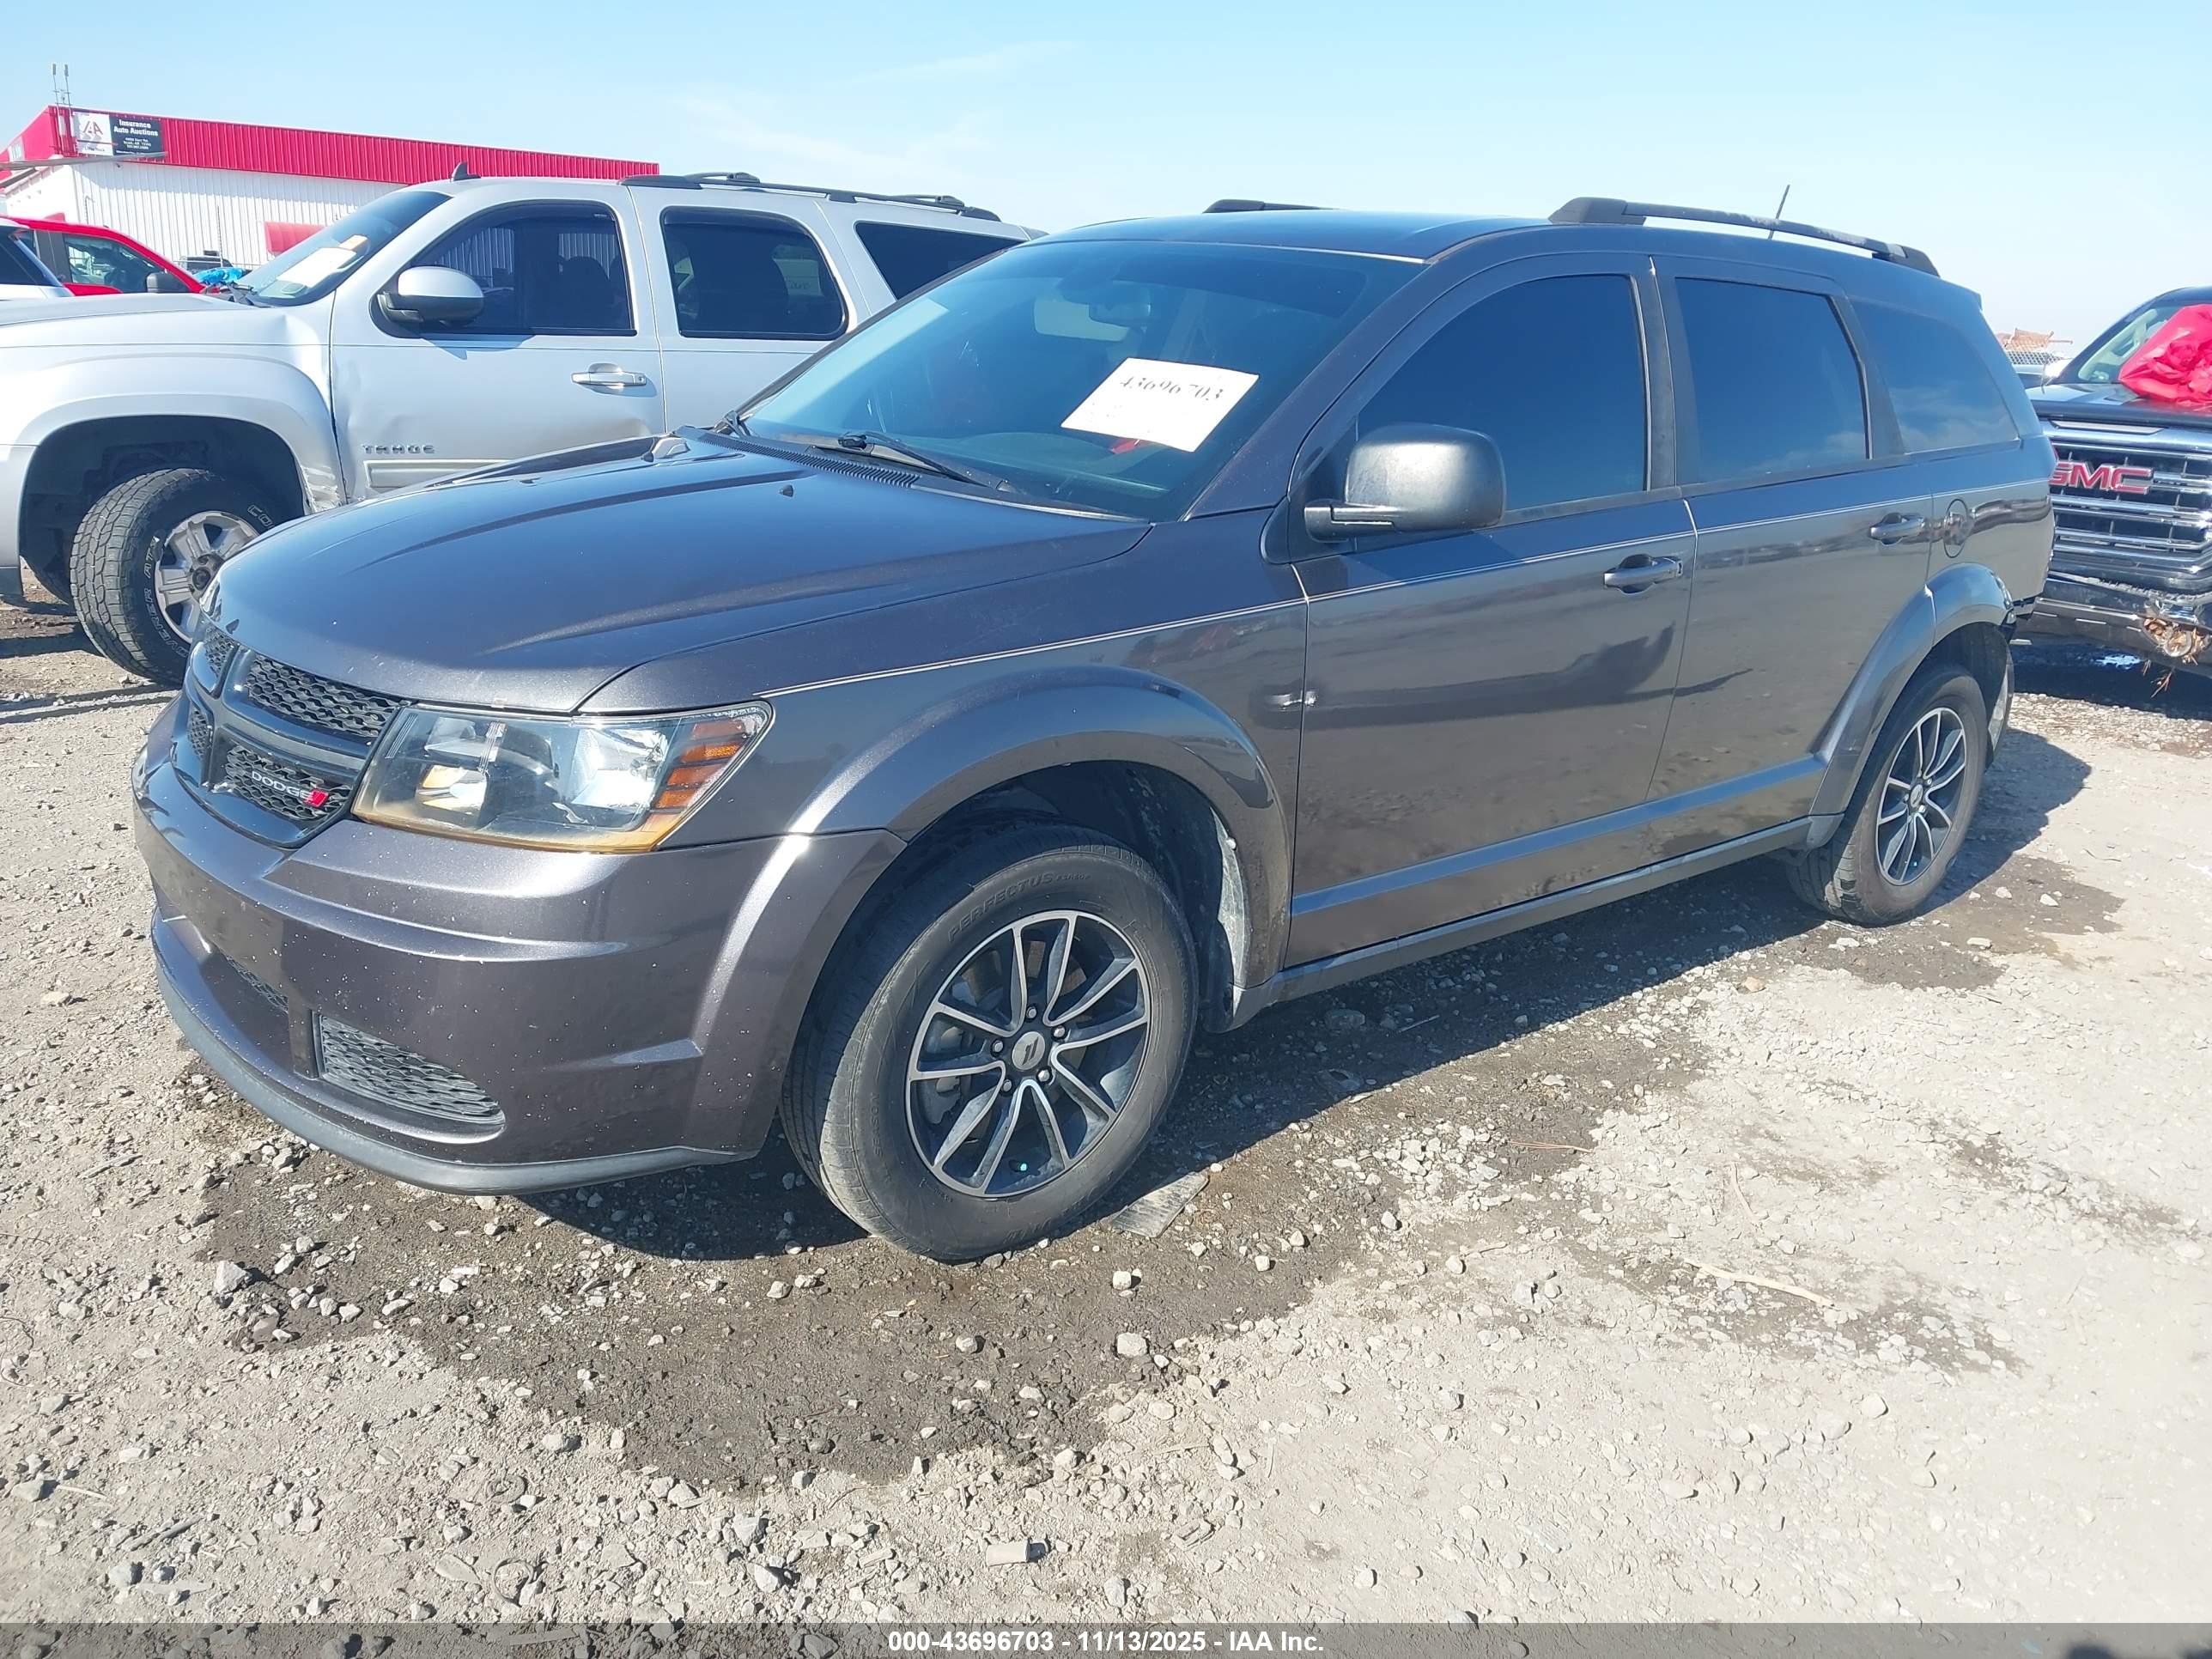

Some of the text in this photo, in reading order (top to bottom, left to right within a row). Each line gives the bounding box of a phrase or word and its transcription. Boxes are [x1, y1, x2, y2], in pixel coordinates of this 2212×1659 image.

[113, 125, 159, 137] Auto Auctions
[118, 118, 151, 129] Insurance
[1120, 376, 1224, 401] 43696703
[362, 444, 435, 455] TAHOE
[252, 770, 313, 803] DODGE
[948, 872, 1055, 943] PERFECTUS
